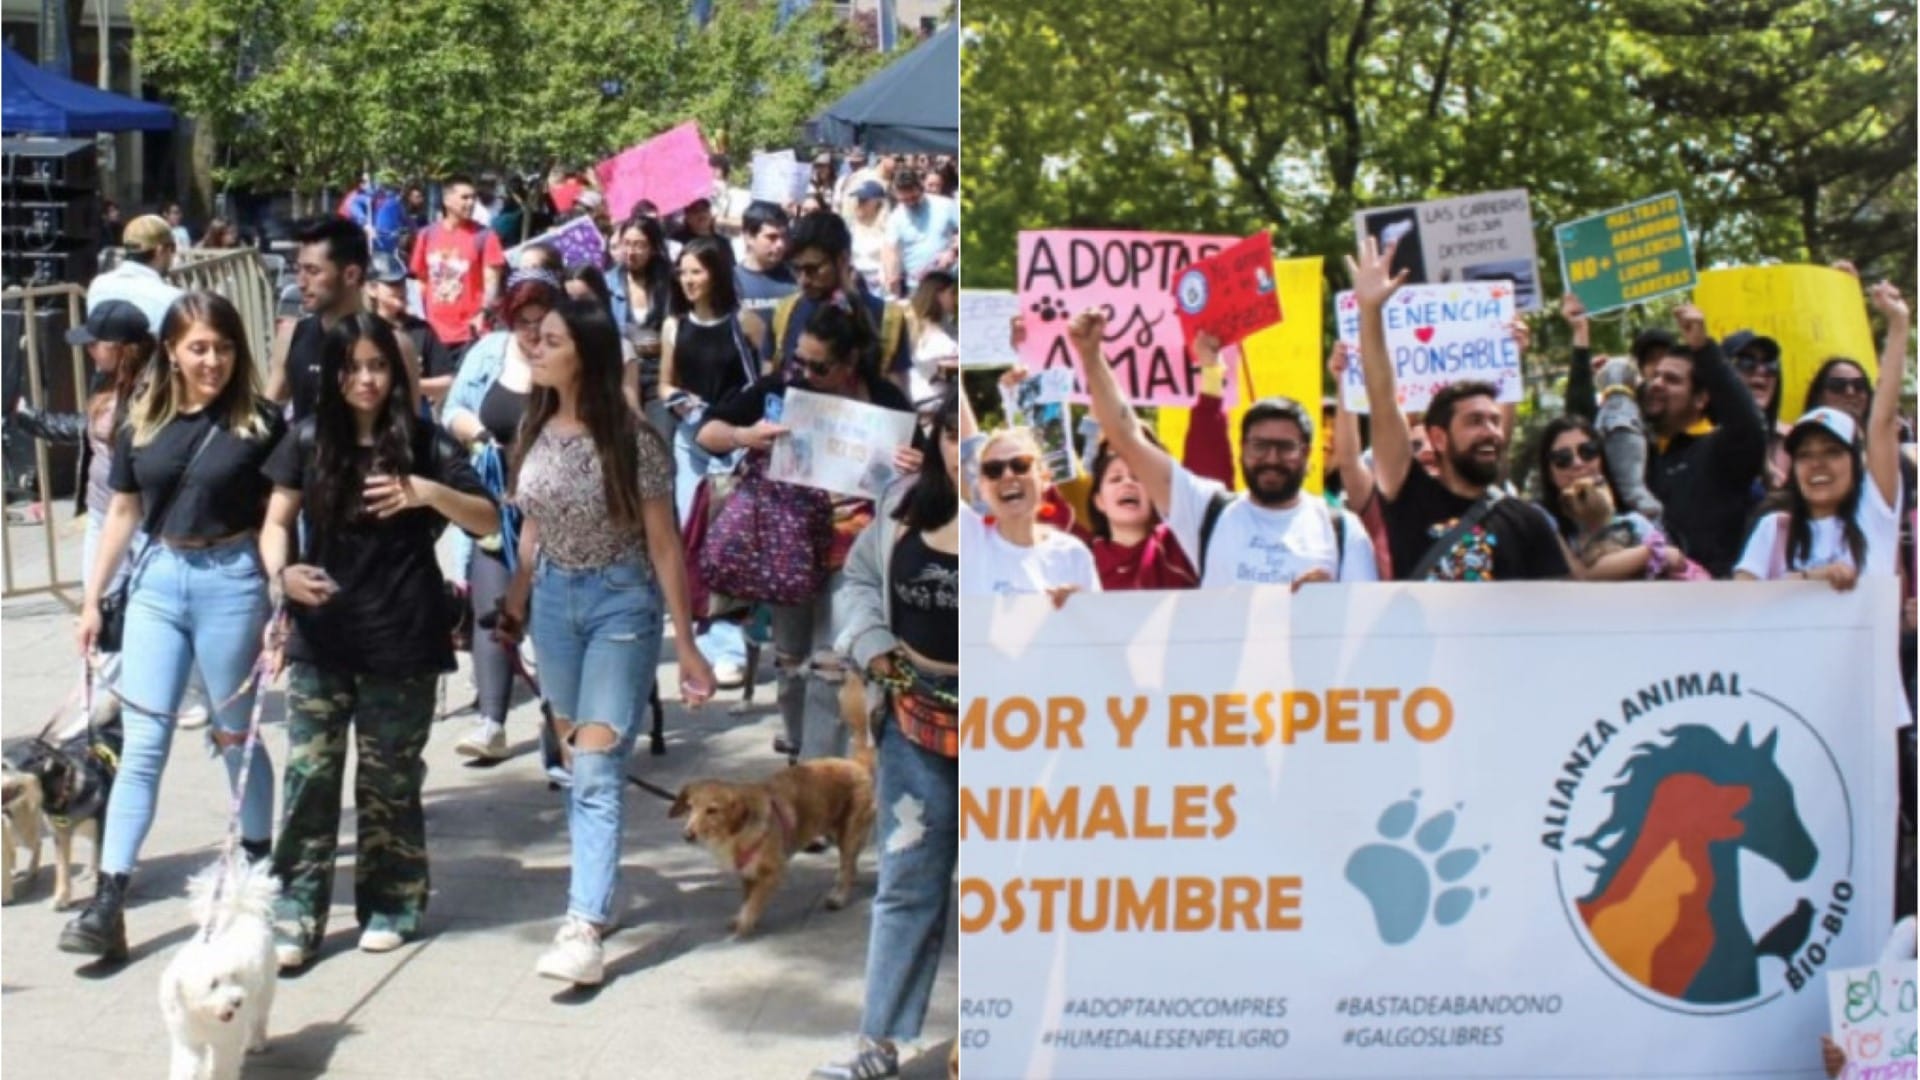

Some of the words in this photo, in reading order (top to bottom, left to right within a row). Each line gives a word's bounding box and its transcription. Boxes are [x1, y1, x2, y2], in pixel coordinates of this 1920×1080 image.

[1569, 256, 1598, 283] NO
[1343, 300, 1502, 334] #ENENCIA
[1348, 336, 1518, 385] RPONSABLE
[1105, 695, 1149, 749] Y
[1168, 686, 1455, 749] RESPETO
[1541, 719, 1618, 851] ALIANZA
[1620, 672, 1743, 724] ANIMAL
[960, 784, 1238, 841] NIMALES
[960, 876, 1303, 934] OSTUMBRE
[1784, 880, 1855, 993] BIO-BIO
[1063, 996, 1288, 1018] #ADOPTANOCOMPRES
[1335, 994, 1562, 1016] #BASTADEABANDONO
[1042, 1026, 1290, 1049] #HUMEDALESENPELIGRO
[1343, 1026, 1504, 1047] #GALGOSLIBRES
